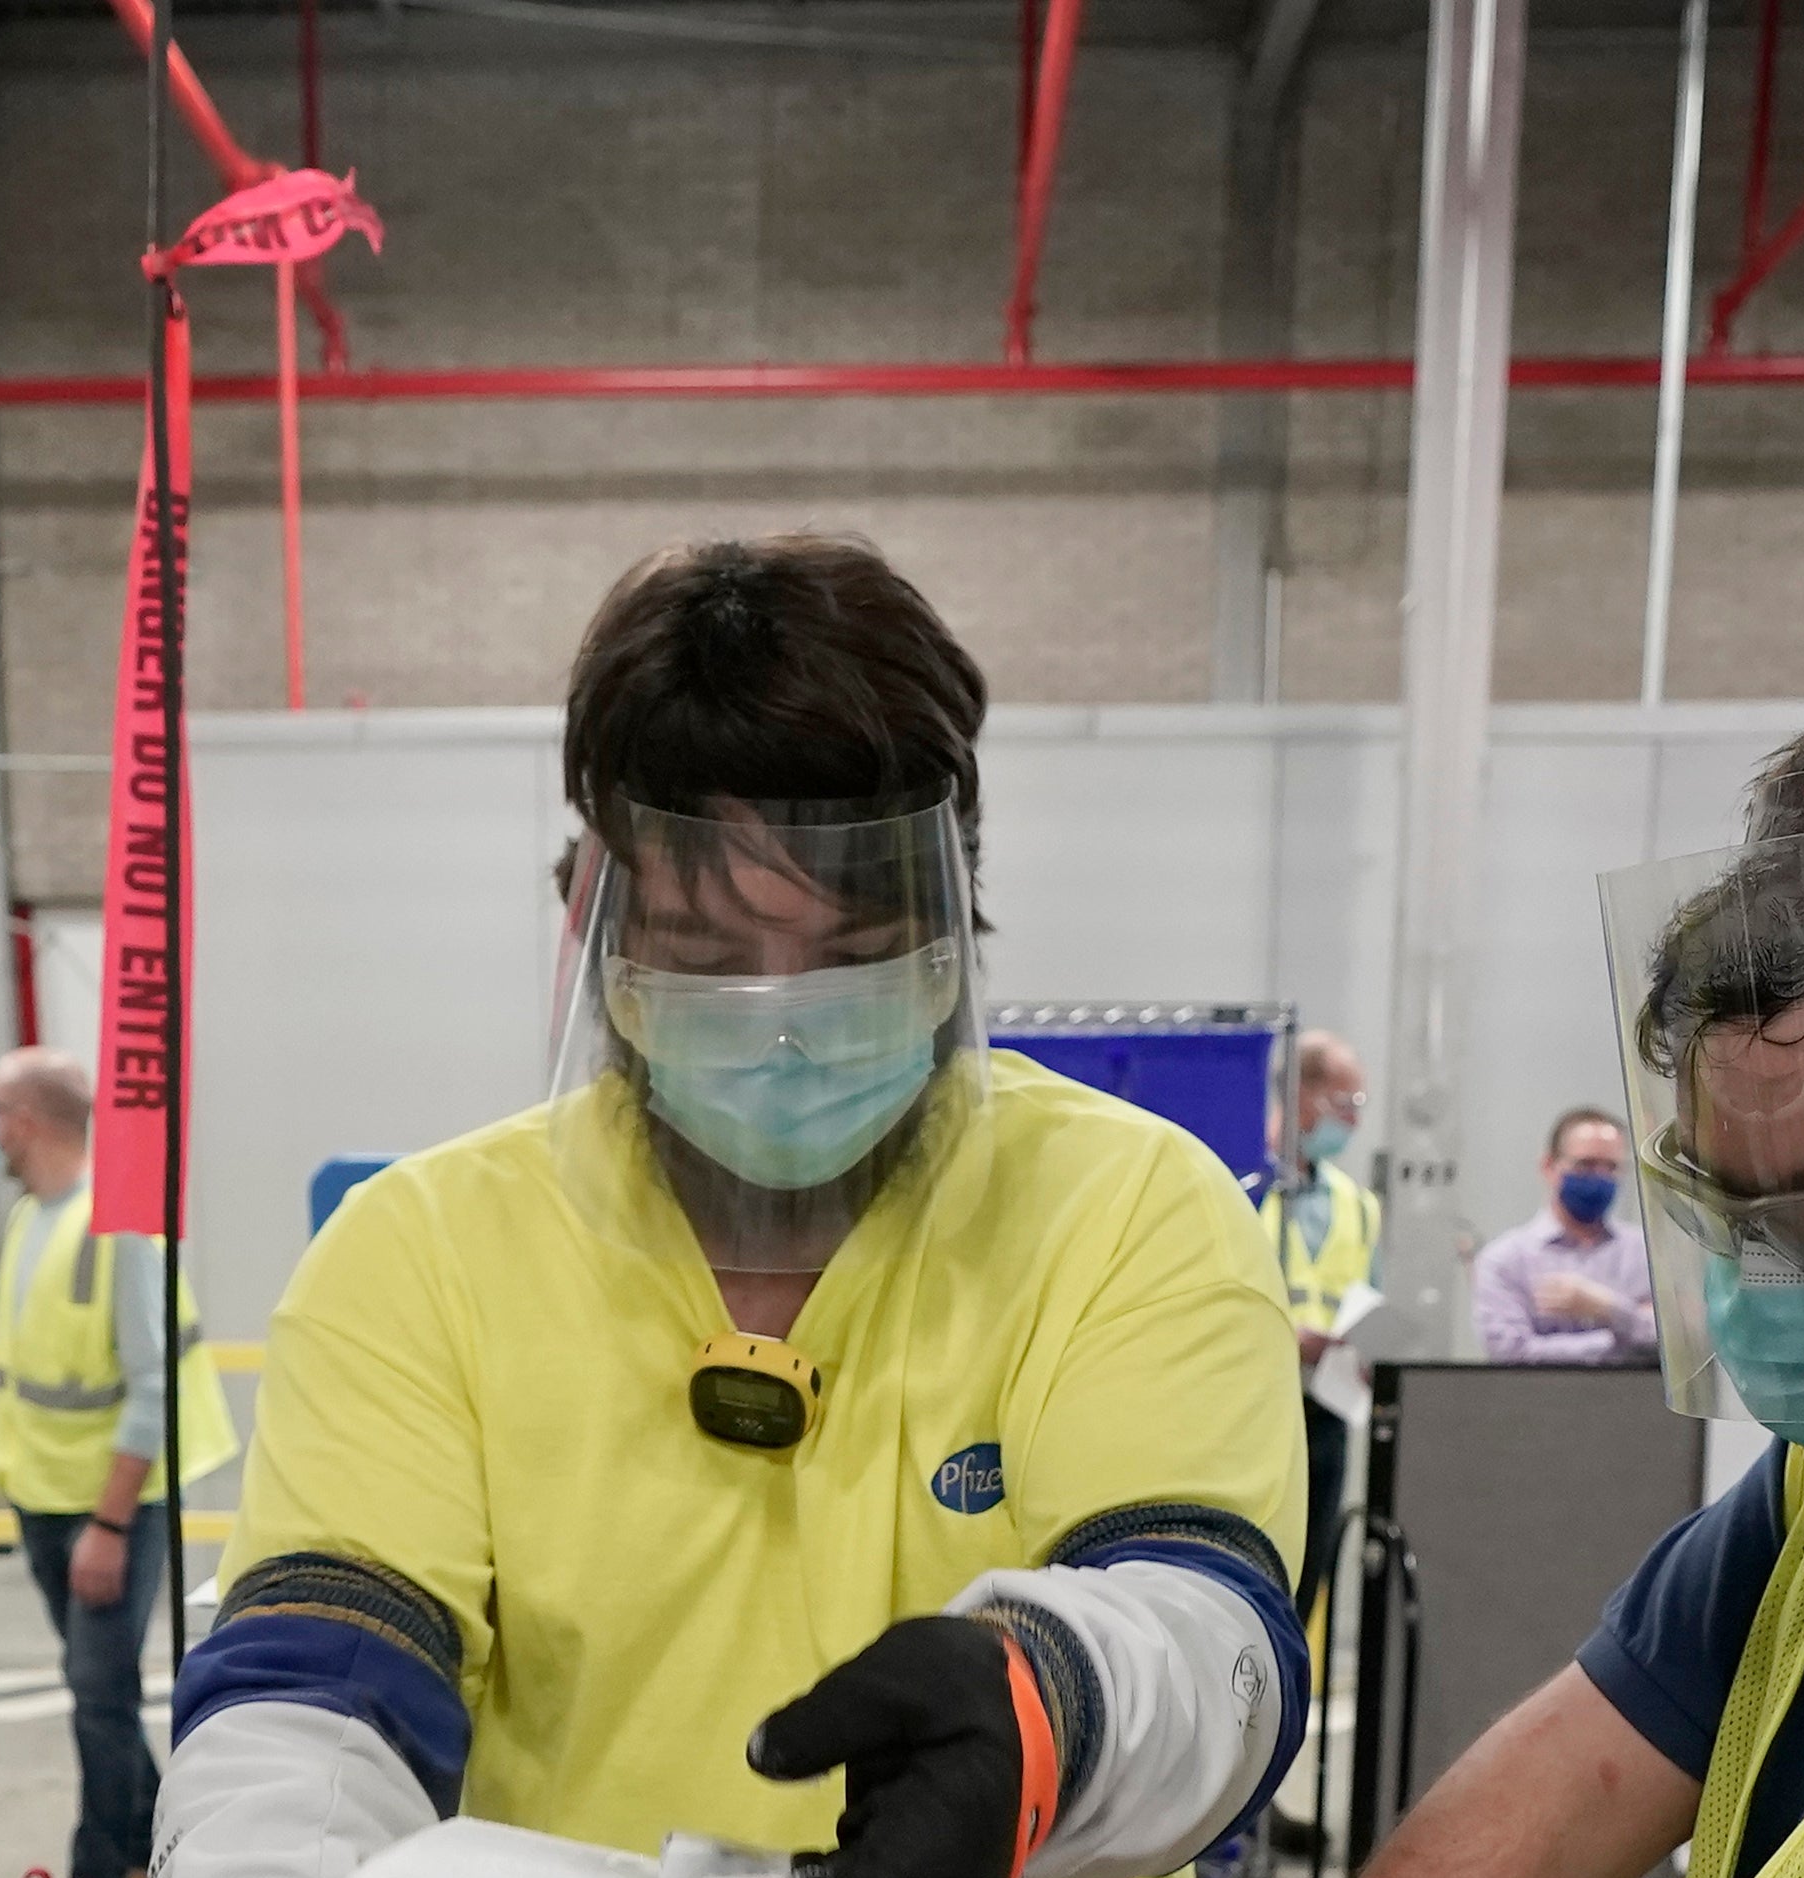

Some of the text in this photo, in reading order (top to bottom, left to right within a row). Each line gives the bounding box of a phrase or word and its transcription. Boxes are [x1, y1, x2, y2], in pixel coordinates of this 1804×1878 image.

[130, 733, 169, 803] DO
[113, 946, 169, 1109] ENTER
[940, 1453, 1004, 1515] Pfize
